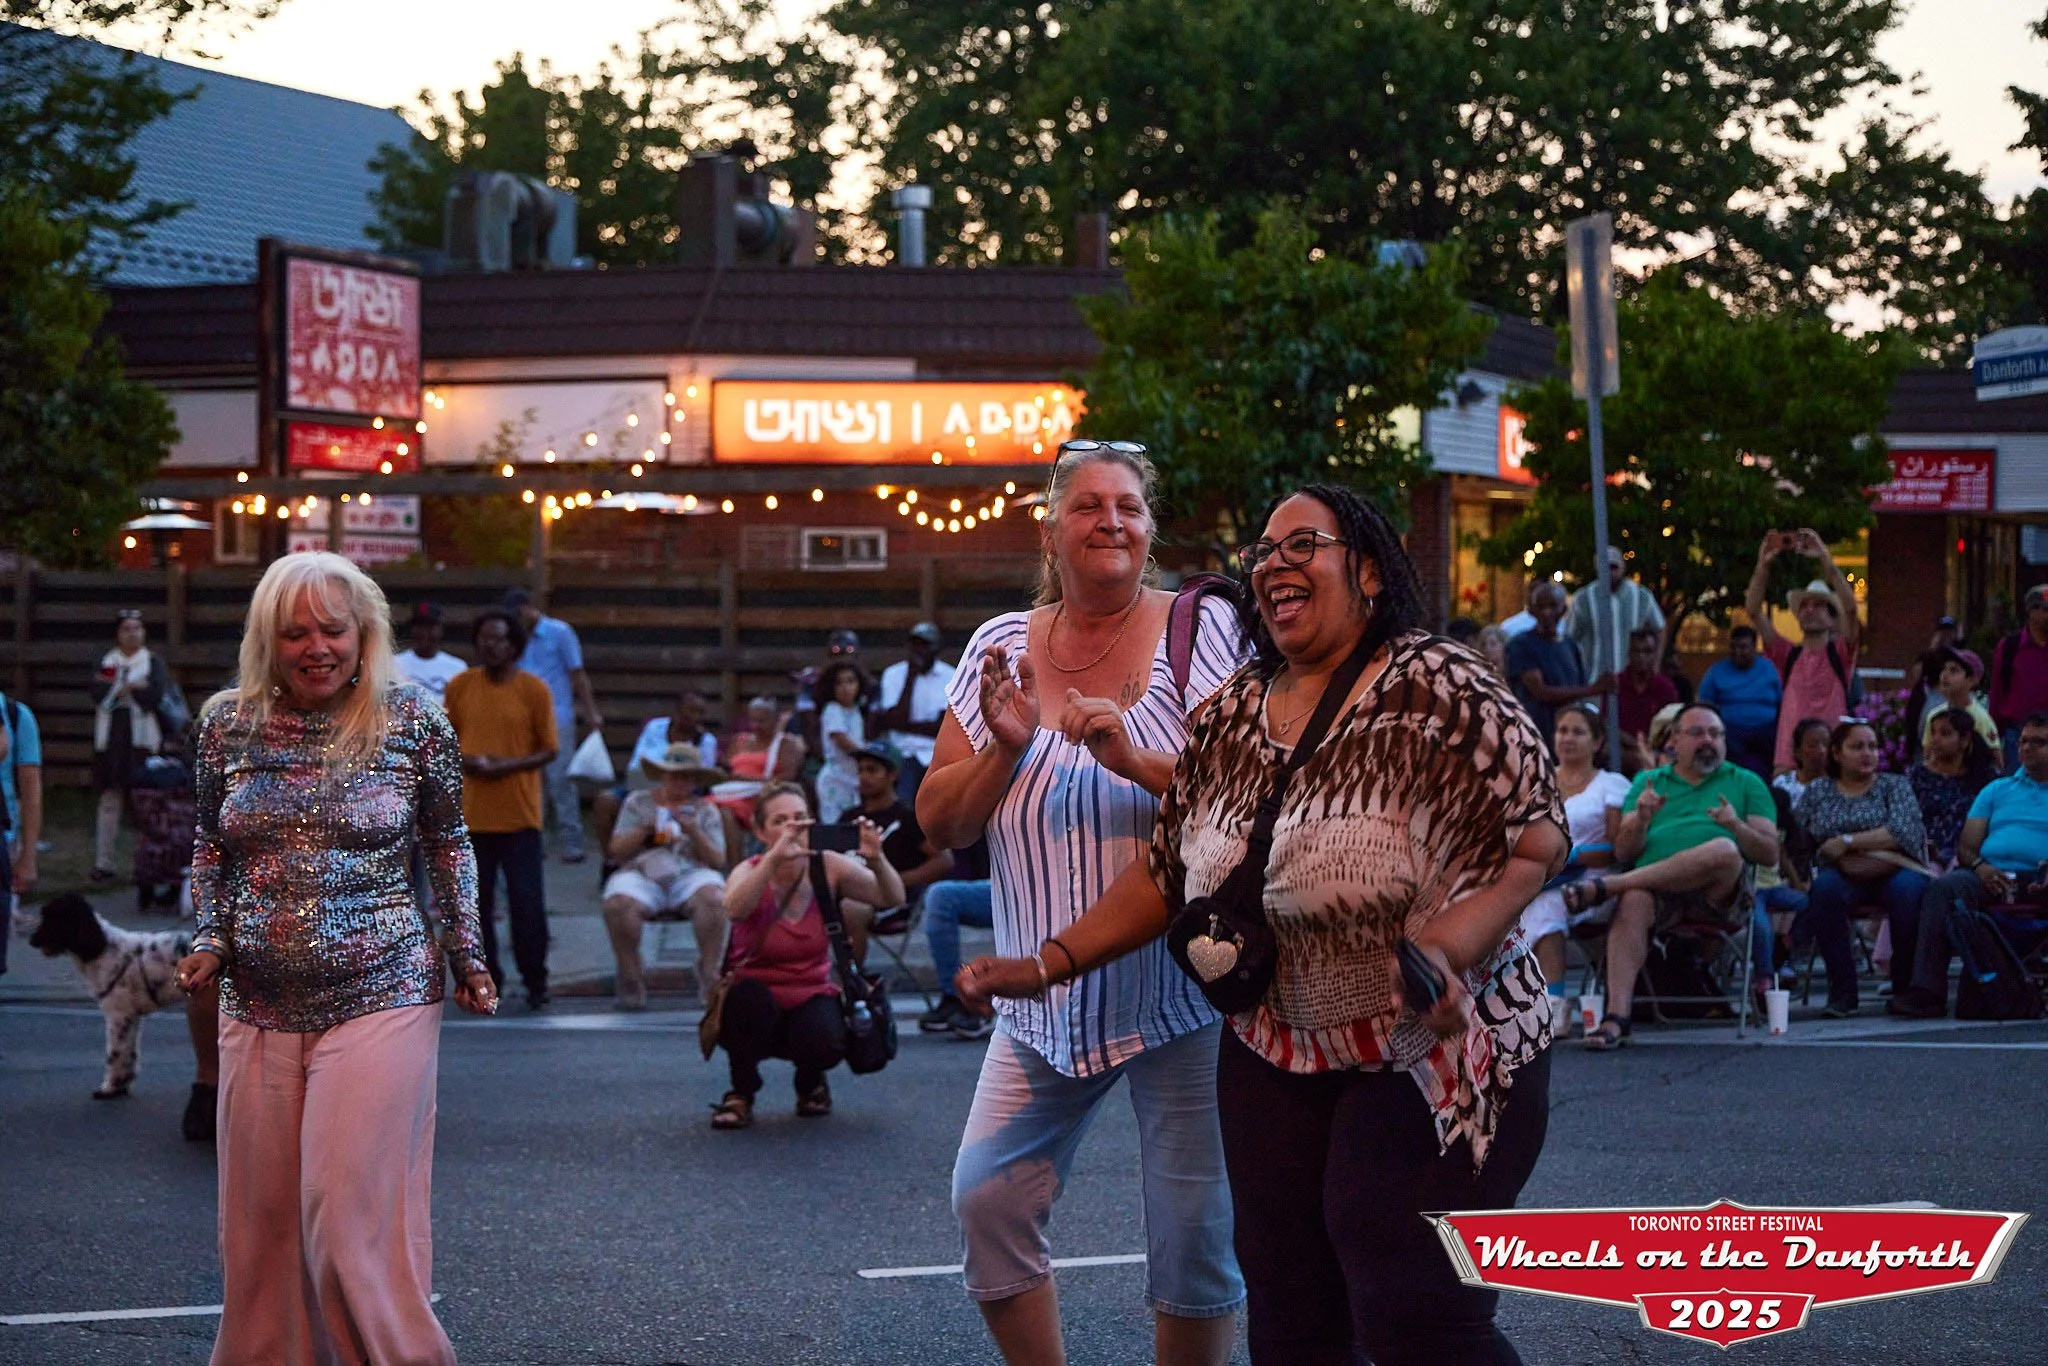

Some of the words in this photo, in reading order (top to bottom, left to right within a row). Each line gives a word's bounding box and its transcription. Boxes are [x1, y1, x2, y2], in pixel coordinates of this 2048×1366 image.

[311, 340, 400, 383] ADDA
[1981, 358, 2037, 382] Danforth
[943, 401, 1074, 435] ADDA
